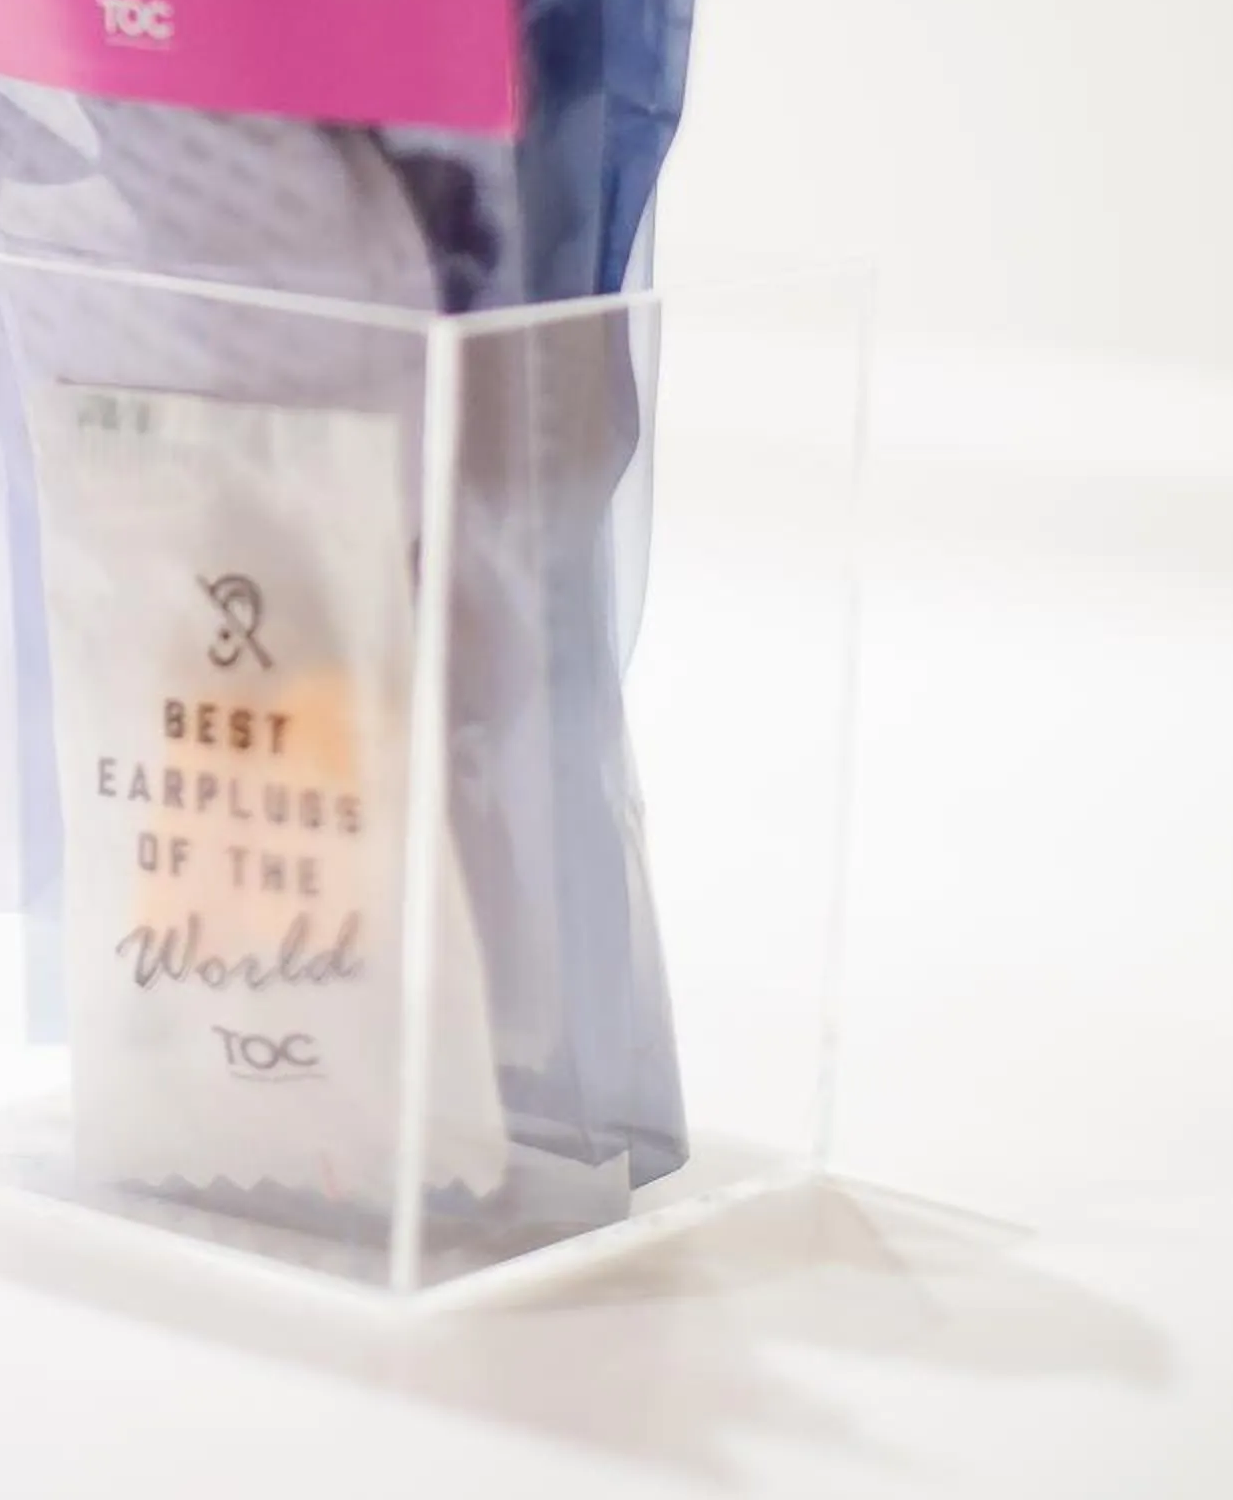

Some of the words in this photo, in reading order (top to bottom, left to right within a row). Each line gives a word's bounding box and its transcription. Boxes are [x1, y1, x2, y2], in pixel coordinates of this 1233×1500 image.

[163, 697, 292, 754] BEST
[96, 756, 362, 834] EARPLUGS
[137, 831, 191, 878] OF
[225, 845, 319, 897] THE
[115, 911, 366, 990] World
[210, 1024, 321, 1071] TOC
